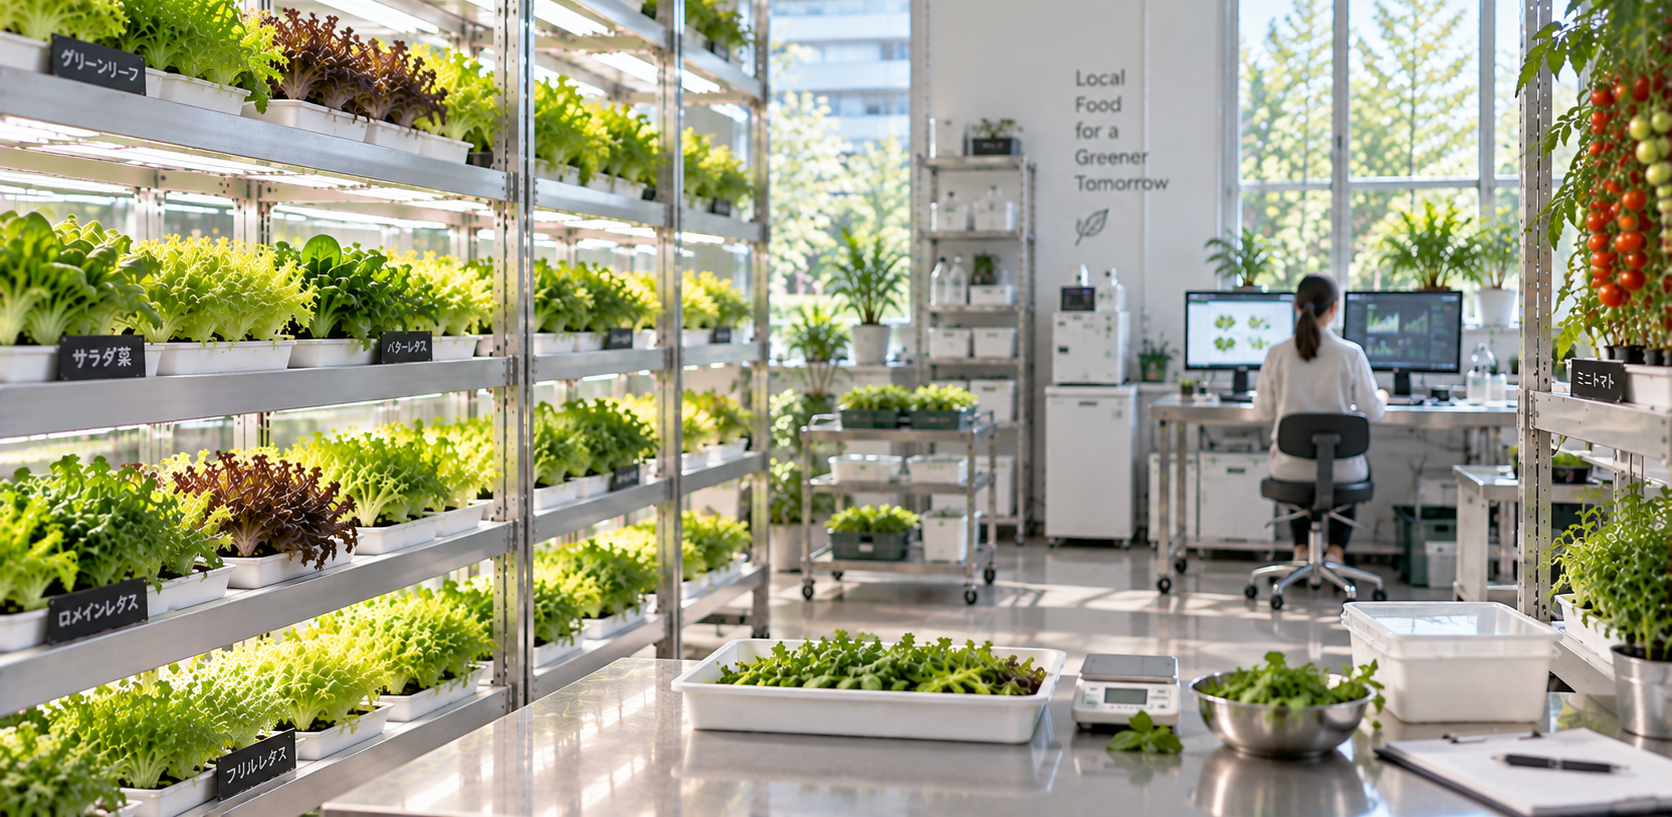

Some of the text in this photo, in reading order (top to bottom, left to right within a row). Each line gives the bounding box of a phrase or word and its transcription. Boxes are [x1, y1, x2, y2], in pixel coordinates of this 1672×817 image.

[61, 49, 139, 81] グリーンリーフ
[1076, 69, 1125, 87] Local
[1076, 95, 1122, 113] Food
[1075, 121, 1119, 139] for a
[1075, 148, 1148, 166] Greener
[1074, 174, 1169, 192] Tomorrow
[1577, 371, 1615, 390] ミニトマト
[58, 594, 139, 628] ロメインレタス
[226, 746, 287, 784] フリルレタス
